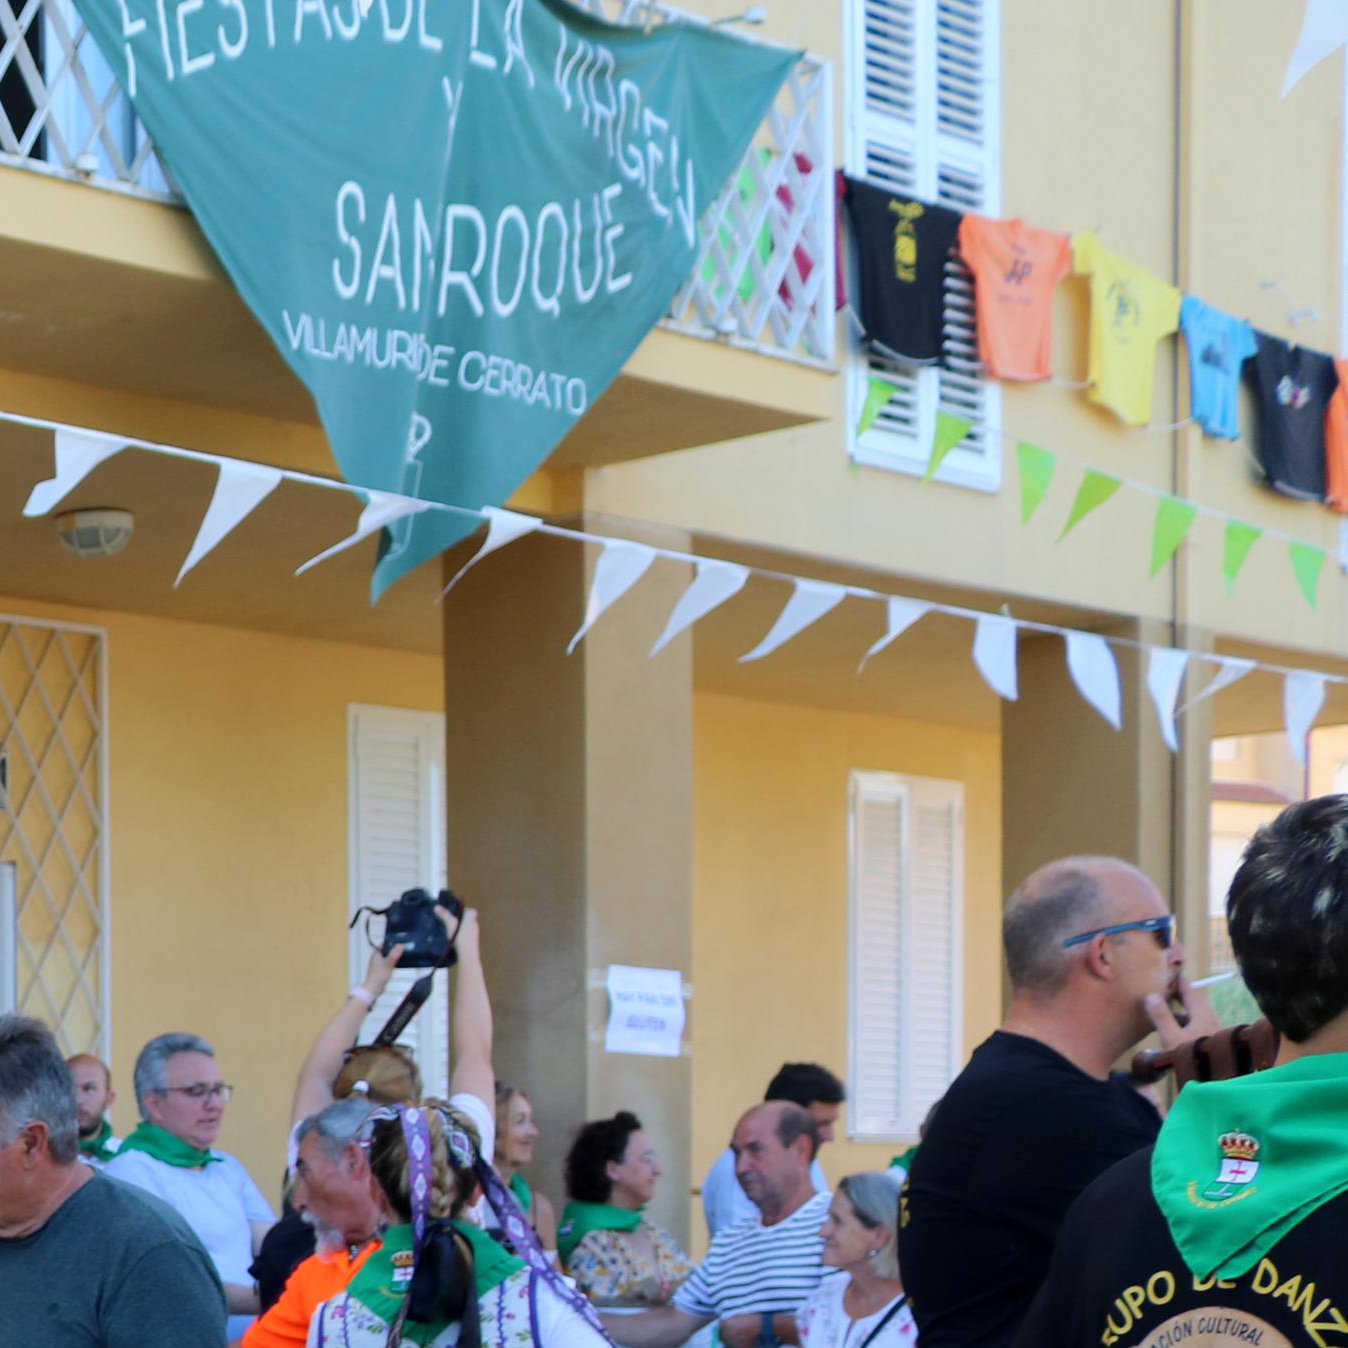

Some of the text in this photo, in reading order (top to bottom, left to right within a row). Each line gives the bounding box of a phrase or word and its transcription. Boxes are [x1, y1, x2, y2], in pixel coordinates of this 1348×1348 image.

[556, 23, 696, 248] VIRGEN
[436, 184, 633, 318] ROQUE
[458, 352, 587, 415] CERRATO
[1197, 1317, 1265, 1346] CULTURAL
